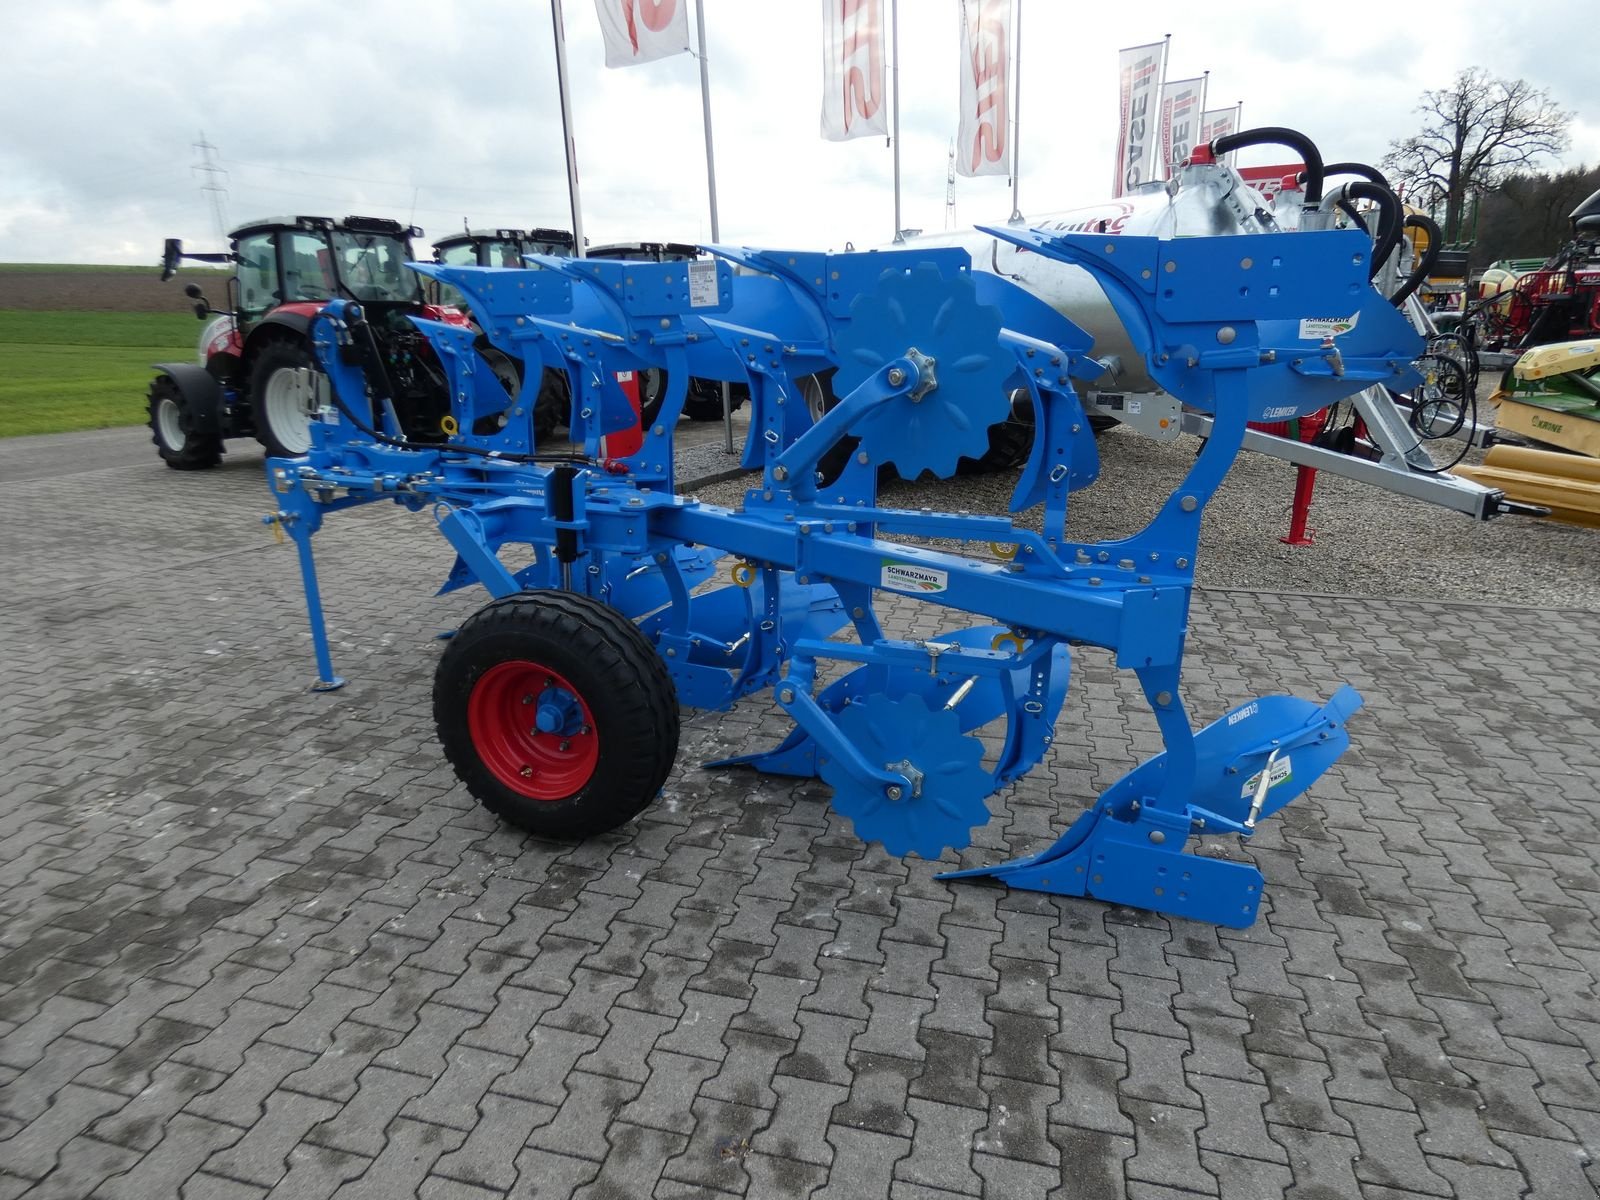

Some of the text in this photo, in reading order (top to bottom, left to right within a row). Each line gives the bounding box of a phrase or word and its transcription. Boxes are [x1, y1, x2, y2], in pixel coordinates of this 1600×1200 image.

[1269, 406, 1298, 418] LEMKEN
[887, 566, 938, 583] SCHWARZMAYR
[1228, 705, 1254, 726] LEMKEN
